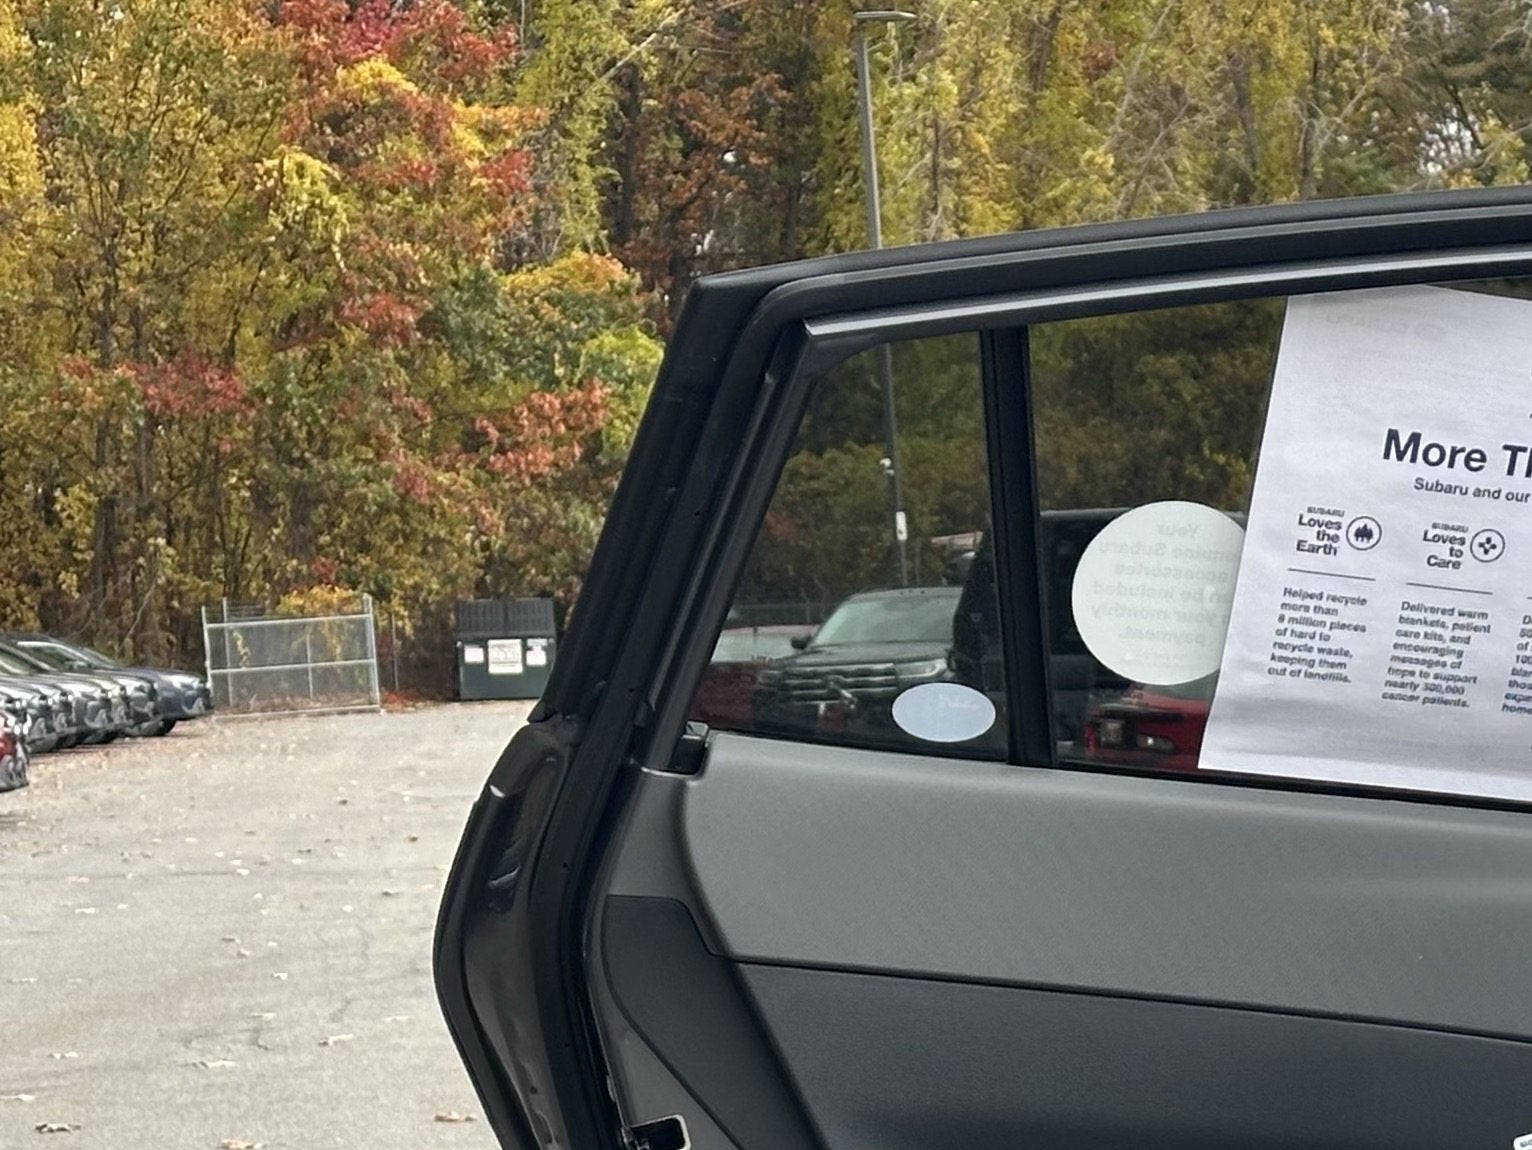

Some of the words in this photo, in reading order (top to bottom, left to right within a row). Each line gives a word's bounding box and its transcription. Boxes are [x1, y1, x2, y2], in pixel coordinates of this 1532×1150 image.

[1382, 428, 1487, 473] More
[1413, 477, 1468, 499] Subaru
[1472, 483, 1502, 500] and
[1506, 488, 1530, 503] our
[1307, 506, 1344, 517] SUBARU
[1298, 514, 1342, 530] Loves
[1316, 530, 1340, 543] the
[1423, 530, 1466, 546] Loves
[1296, 540, 1337, 556] Earth
[1449, 546, 1463, 558] to
[1427, 555, 1461, 570] Care
[1283, 587, 1323, 601] Helped
[1326, 593, 1367, 606] recycle
[1281, 603, 1310, 613] more
[1313, 605, 1338, 616] than
[1401, 601, 1455, 616] Delivered
[1457, 609, 1488, 620] warm
[1288, 616, 1326, 628] million
[1329, 620, 1366, 633] pieces
[1398, 615, 1449, 630] blankets,
[1452, 621, 1491, 634] patient
[1276, 627, 1286, 637] of
[1290, 629, 1316, 640] hard
[1319, 632, 1330, 641] to
[1396, 629, 1420, 639] care
[1423, 631, 1446, 643] kits,
[1450, 634, 1471, 644] and
[1273, 641, 1314, 653] recycle
[1317, 647, 1352, 659] waste,
[1393, 641, 1464, 658] encouraging
[1517, 642, 1529, 651] of
[1270, 653, 1315, 669] keeping
[1318, 658, 1346, 669] them
[1390, 654, 1447, 669] messages
[1450, 660, 1462, 669] of
[1268, 668, 1286, 676] out
[1289, 669, 1301, 678] of
[1303, 670, 1351, 683] landfills.
[1388, 667, 1415, 678] hope
[1419, 670, 1430, 680] to
[1432, 671, 1477, 684] support
[1384, 679, 1419, 692] nearly
[1381, 693, 1420, 701] cancer
[1422, 695, 1470, 708] patients.
